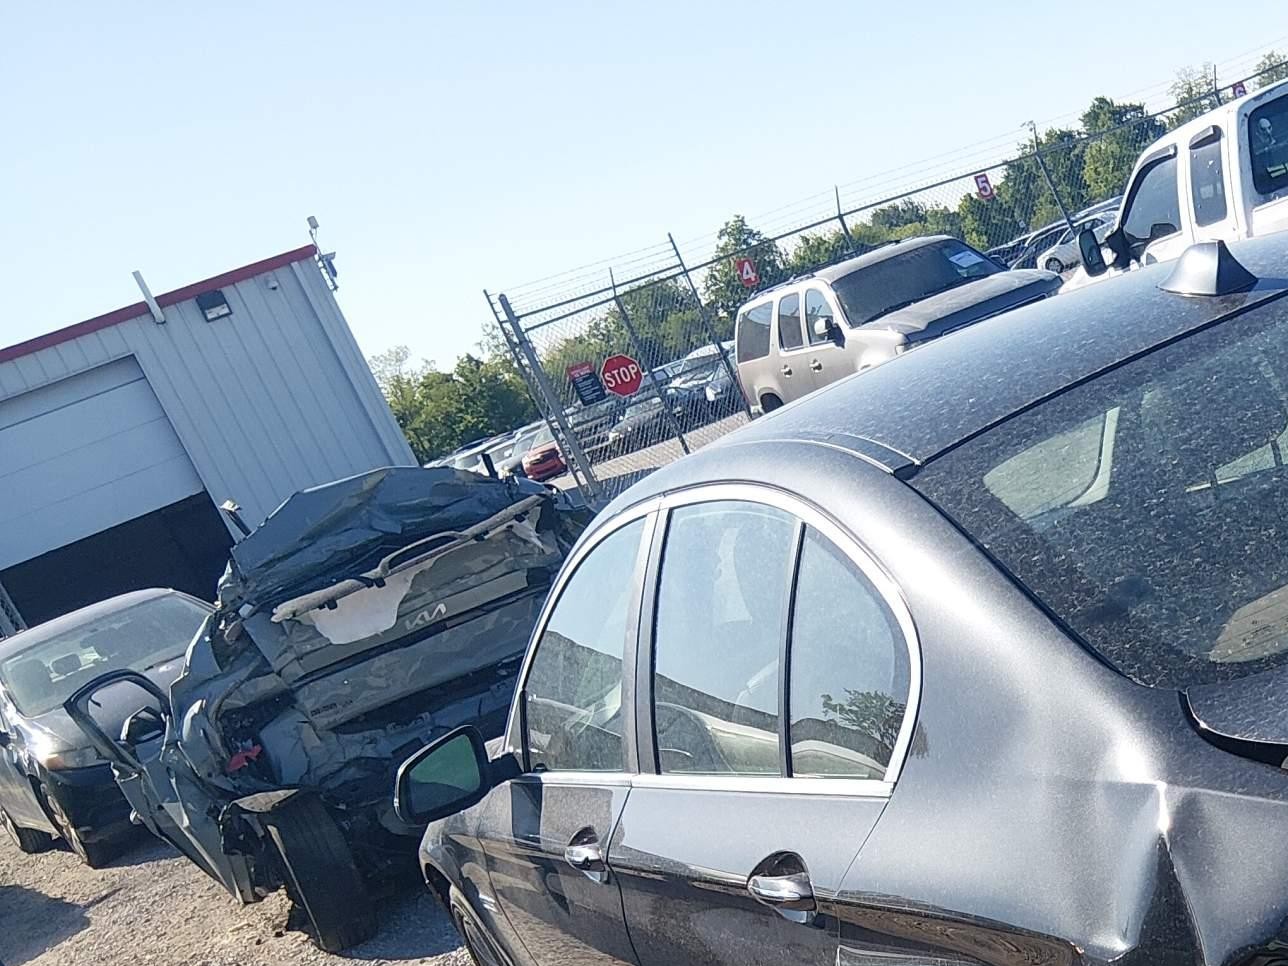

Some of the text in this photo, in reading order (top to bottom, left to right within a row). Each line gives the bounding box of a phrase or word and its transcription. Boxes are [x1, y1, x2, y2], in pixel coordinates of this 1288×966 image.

[977, 175, 991, 196] 5
[743, 261, 756, 281] 4
[604, 363, 638, 388] STOP
